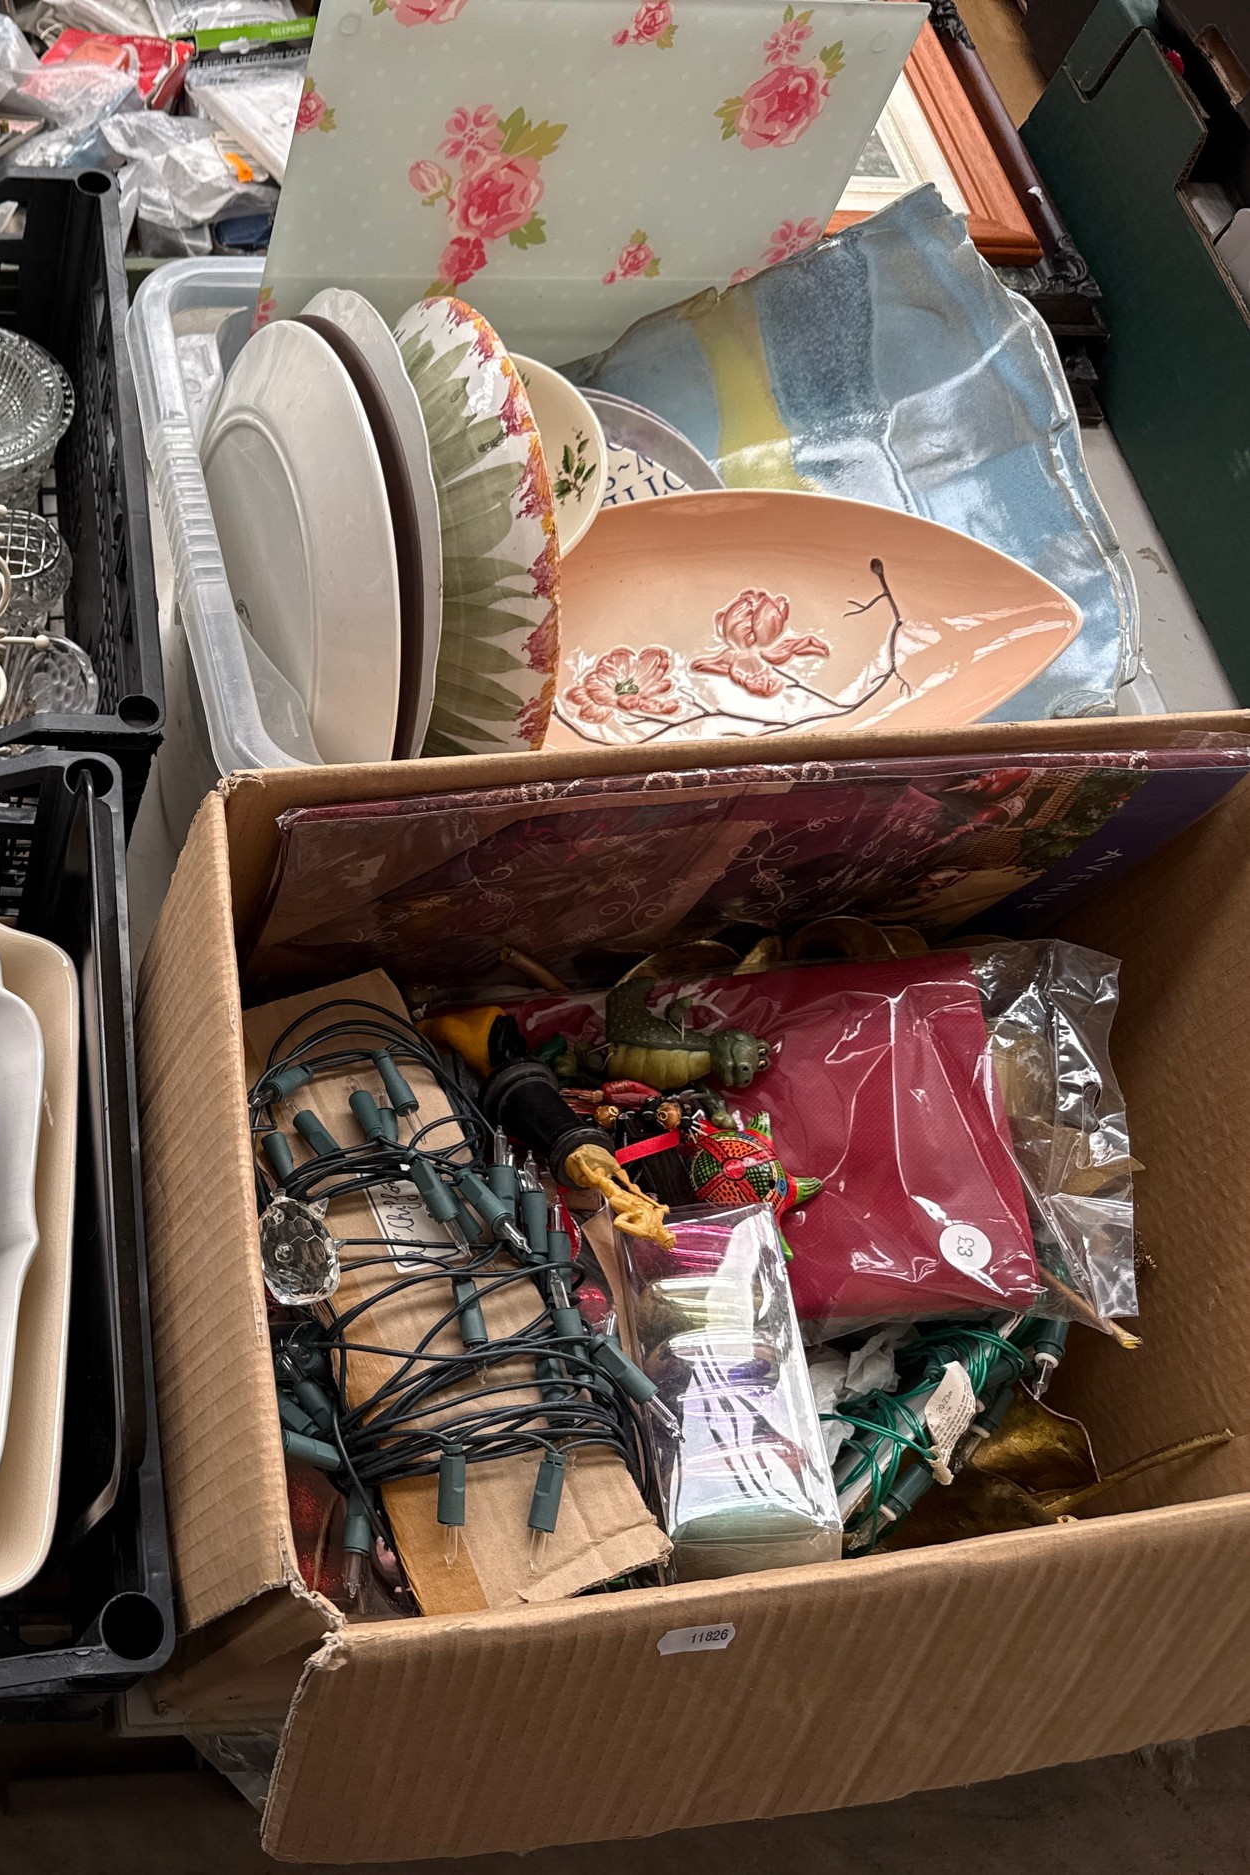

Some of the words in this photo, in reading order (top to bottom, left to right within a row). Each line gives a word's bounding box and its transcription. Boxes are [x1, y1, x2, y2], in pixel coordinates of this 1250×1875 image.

[1017, 848, 1123, 909] AVENUE
[956, 1235, 975, 1258] £3
[691, 1629, 729, 1643] 11826
